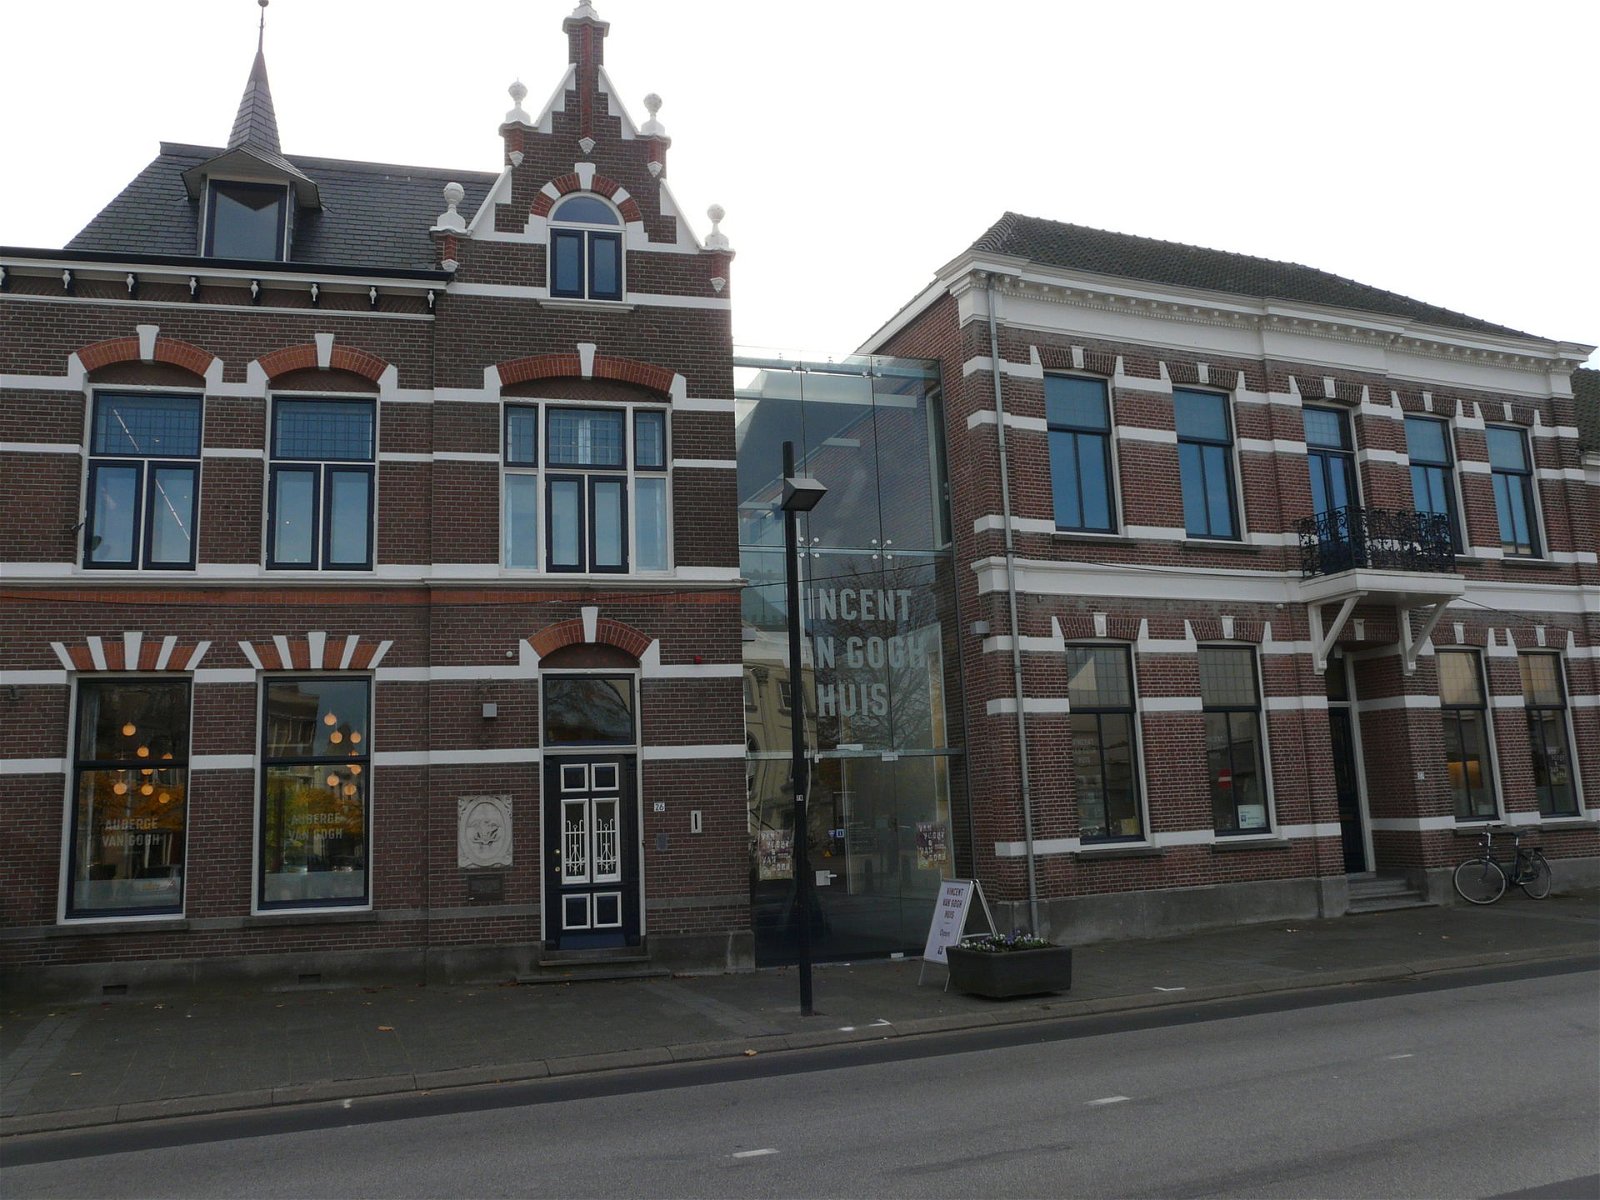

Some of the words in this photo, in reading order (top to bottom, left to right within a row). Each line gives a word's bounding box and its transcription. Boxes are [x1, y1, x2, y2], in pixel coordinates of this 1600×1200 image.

[787, 588, 911, 620] INCENT
[846, 636, 926, 668] GOGH
[817, 683, 887, 717] HUIS
[655, 803, 664, 811] 26
[104, 816, 160, 831] AUBERGE
[291, 812, 342, 825] AUBERGE
[102, 834, 124, 848] VAN
[128, 833, 160, 847] GOGH
[288, 830, 310, 841] VAN
[313, 828, 343, 841] GOGH
[946, 887, 964, 897] VINCENT
